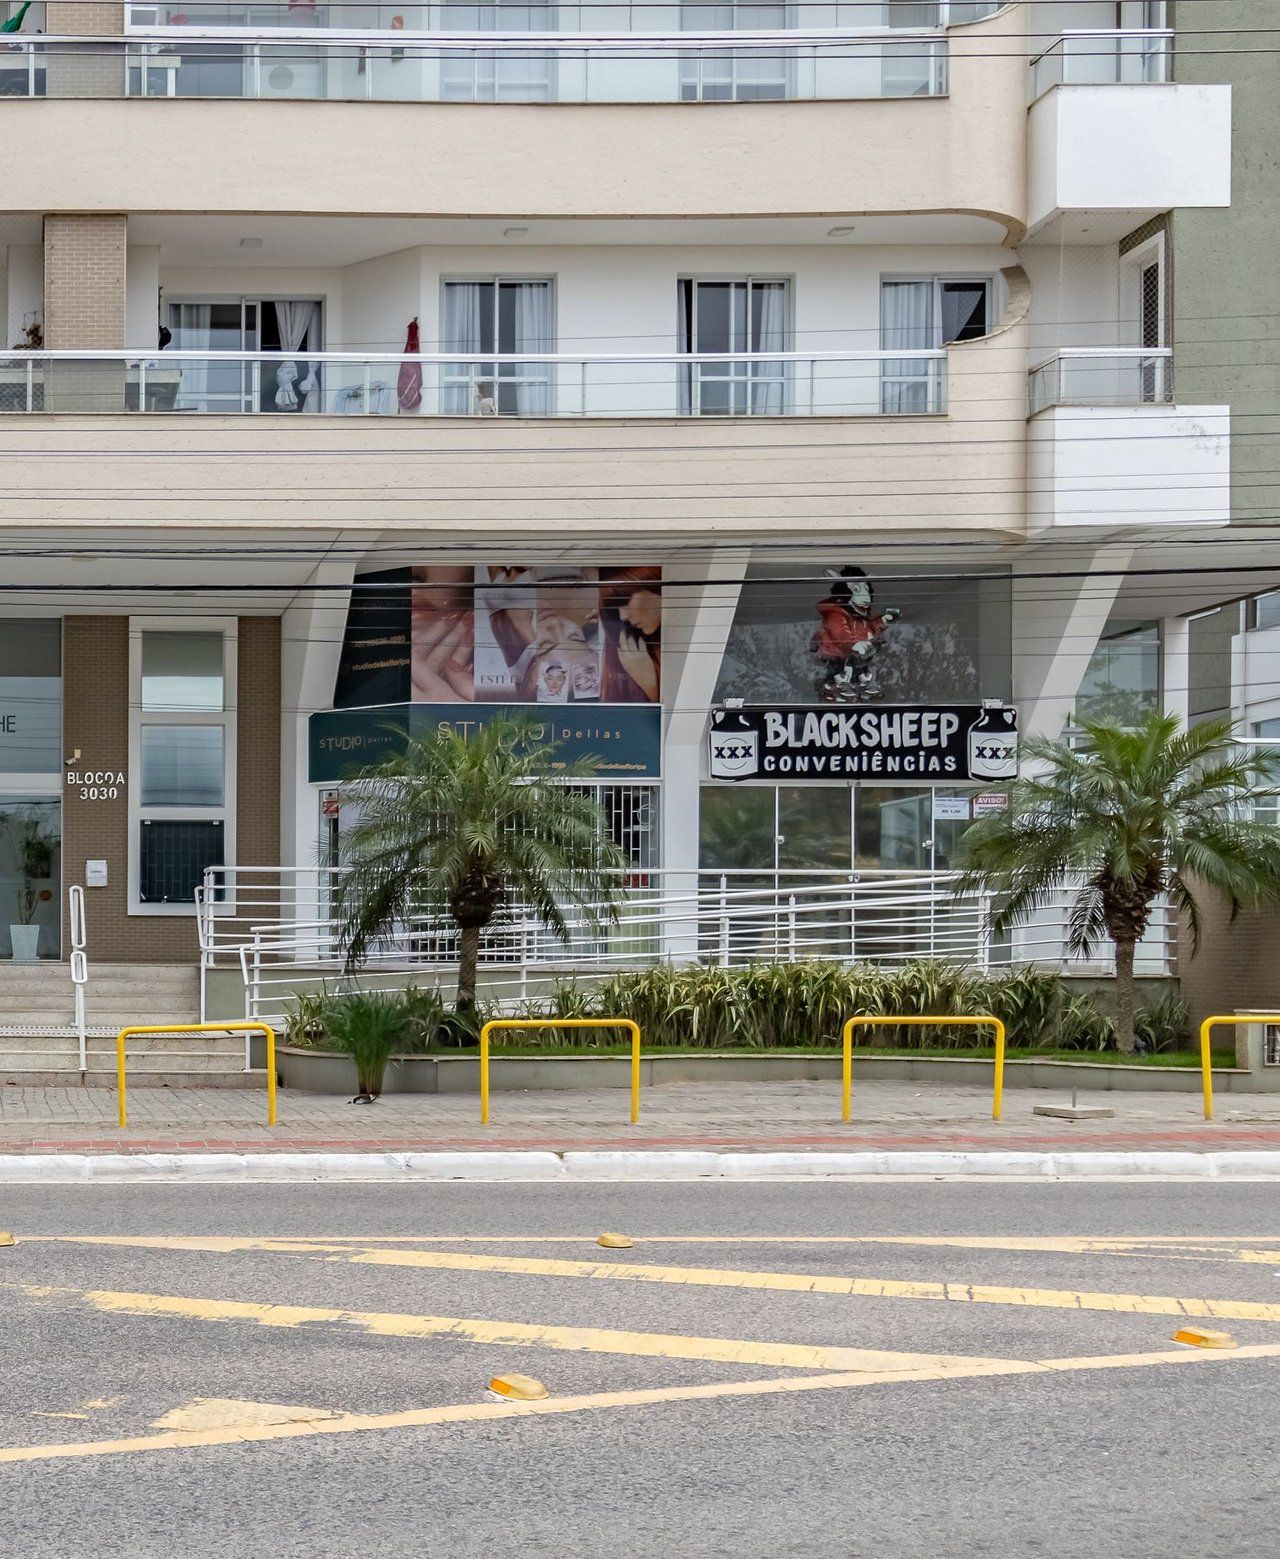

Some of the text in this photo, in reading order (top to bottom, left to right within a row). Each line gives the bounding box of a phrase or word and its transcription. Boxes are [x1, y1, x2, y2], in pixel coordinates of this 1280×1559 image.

[562, 729, 621, 738] Dellas
[764, 712, 959, 749] BLACKSHEEP
[319, 735, 362, 751] STUDIO
[714, 745, 754, 760] XXX
[763, 751, 957, 772] CONVENIÊNCIAS
[67, 772, 125, 785] BLOCO A
[80, 787, 118, 800] 3030
